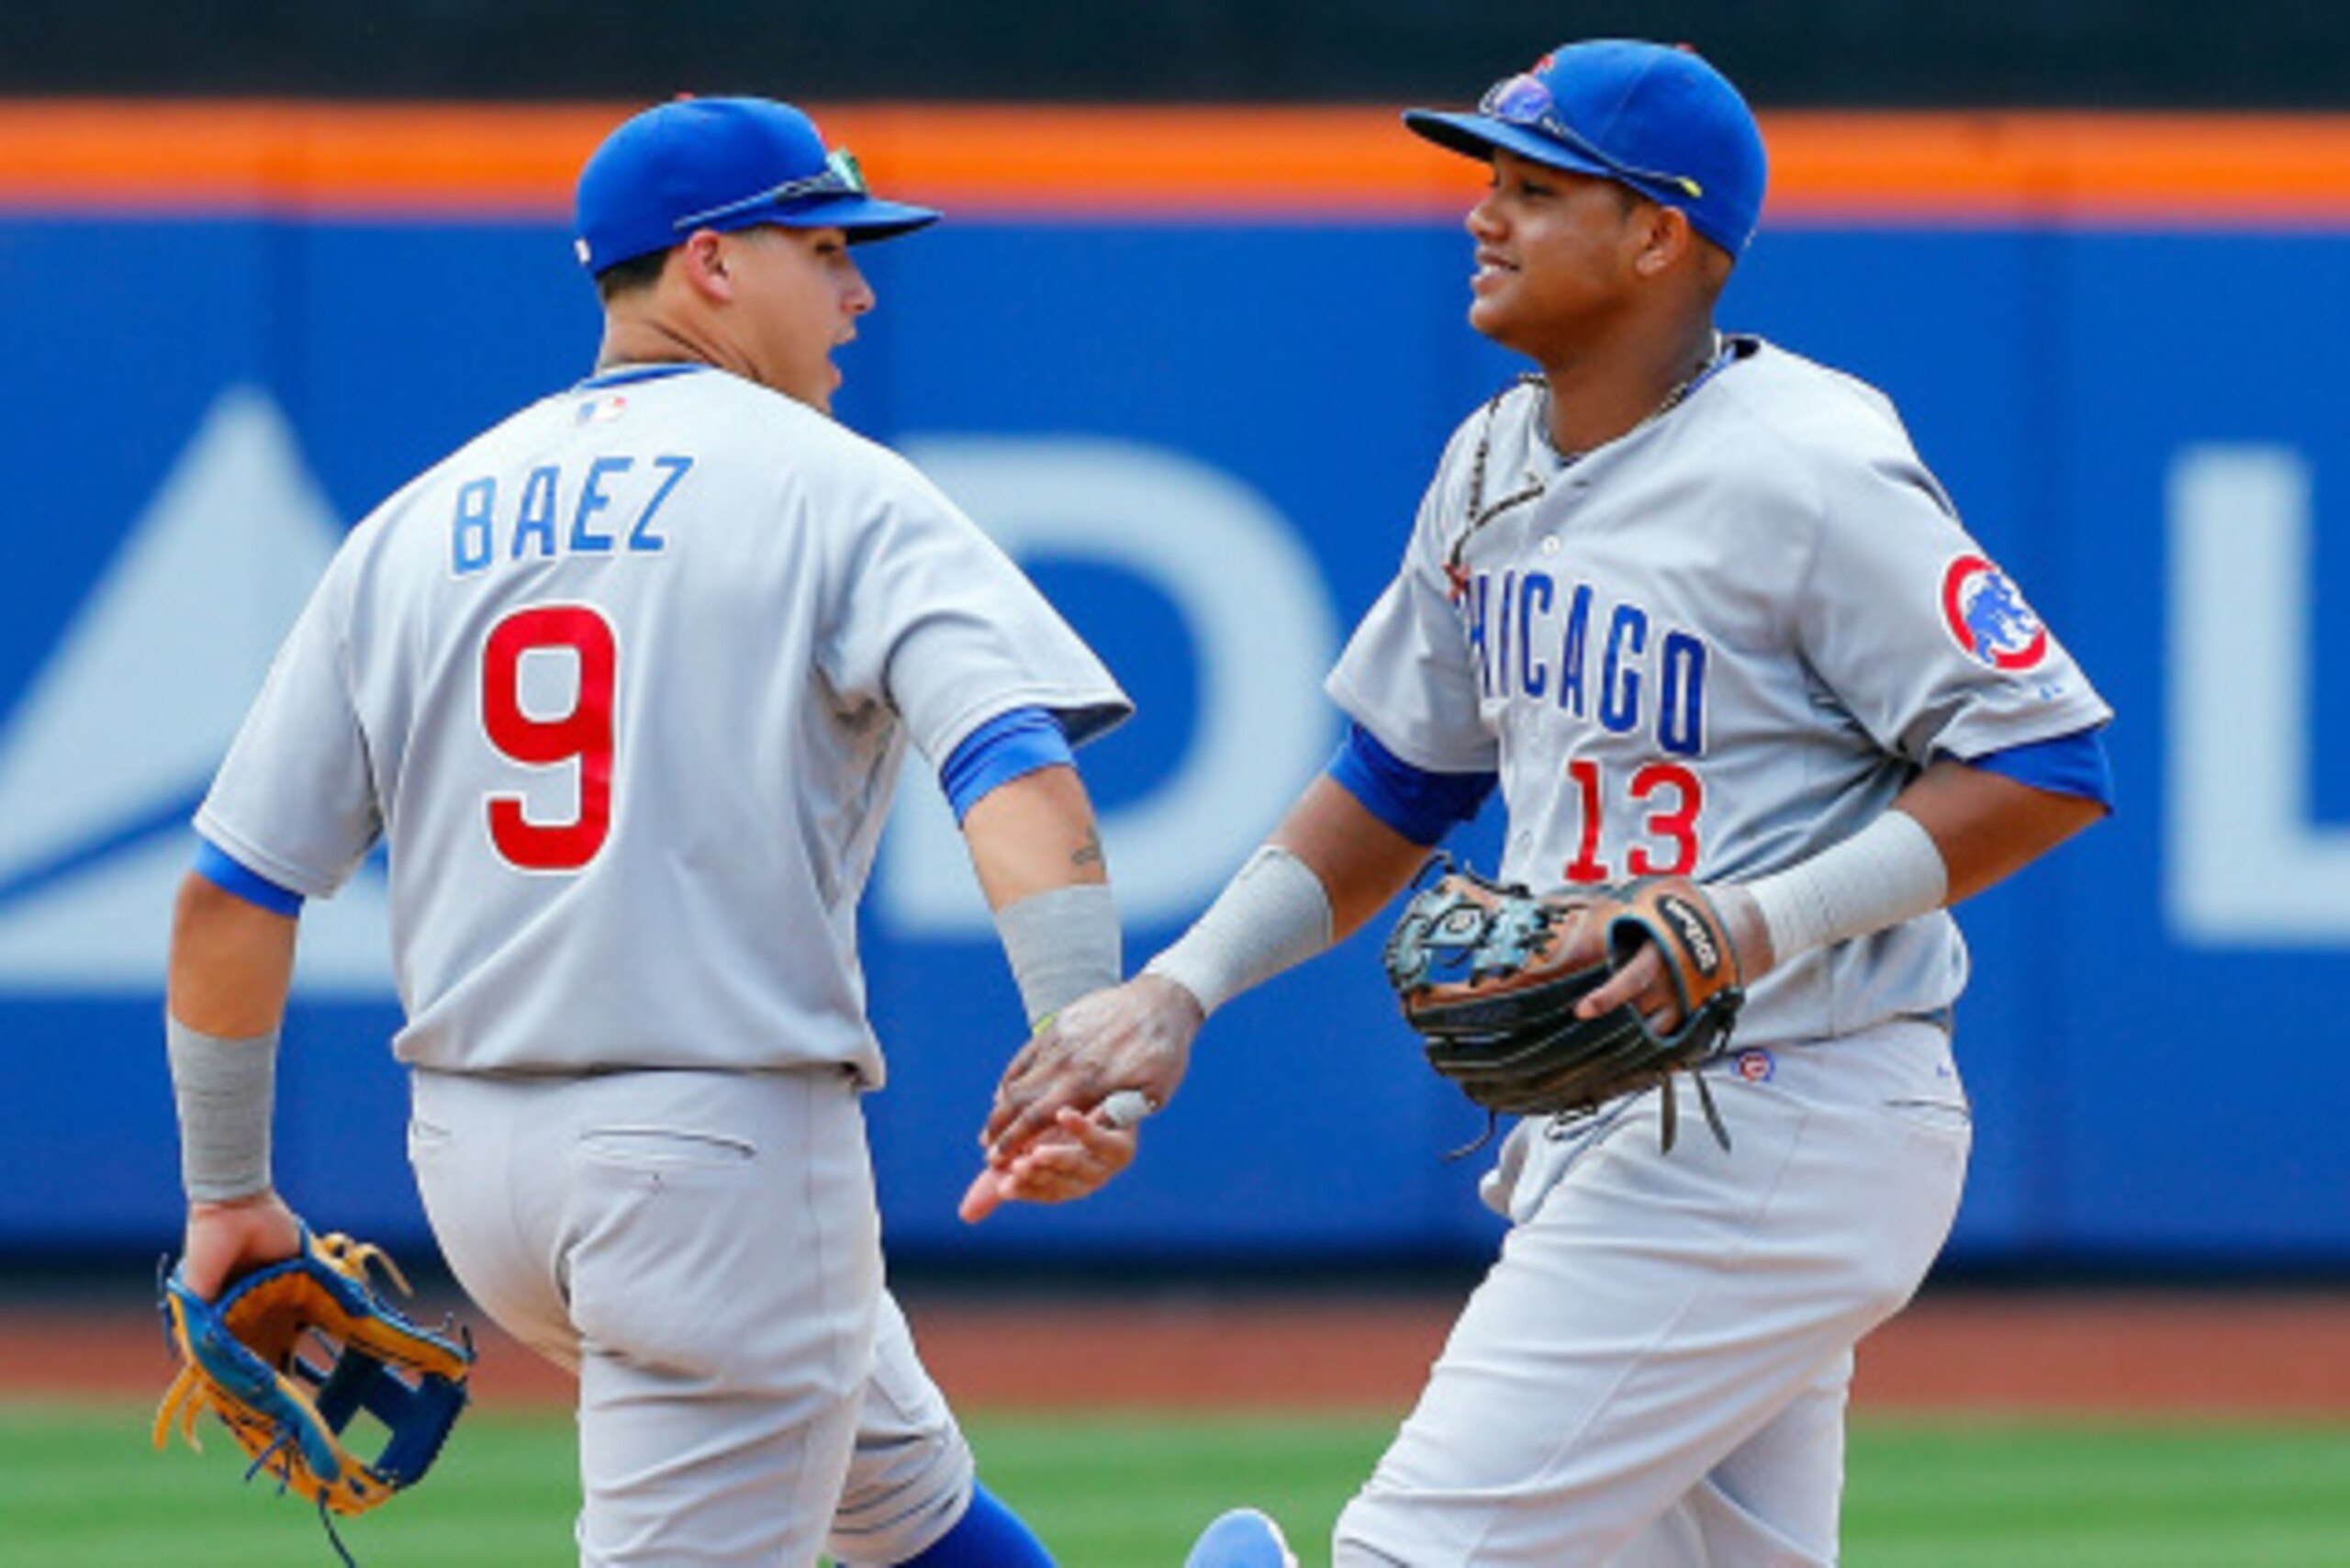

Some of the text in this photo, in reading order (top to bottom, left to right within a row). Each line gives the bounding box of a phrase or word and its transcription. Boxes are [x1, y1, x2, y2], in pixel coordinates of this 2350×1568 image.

[452, 455, 694, 576] BAEZ
[480, 602, 617, 872] 9
[1453, 567, 1707, 757] HICAGO
[1564, 758, 1703, 884] 13
